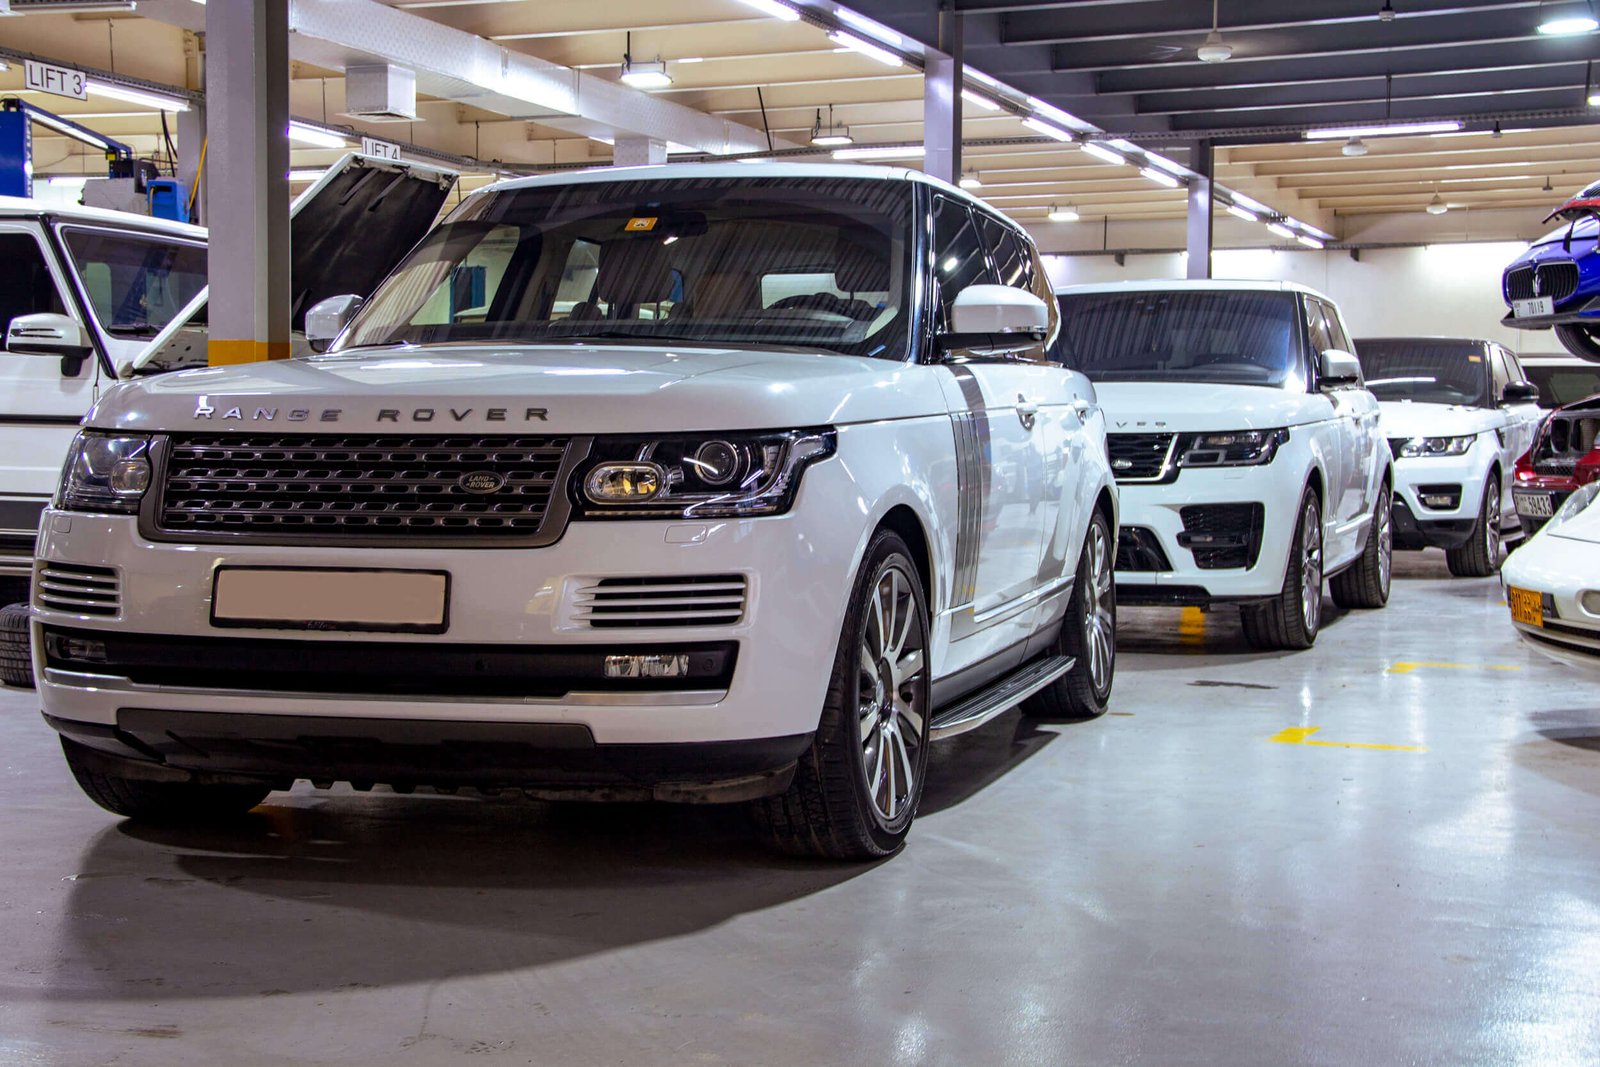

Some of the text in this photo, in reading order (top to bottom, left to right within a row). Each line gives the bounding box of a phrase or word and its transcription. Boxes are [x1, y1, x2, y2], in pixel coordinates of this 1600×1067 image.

[29, 64, 82, 95] LIFT 3
[193, 405, 550, 423] RANGE ROVER
[1527, 496, 1552, 515] 59433
